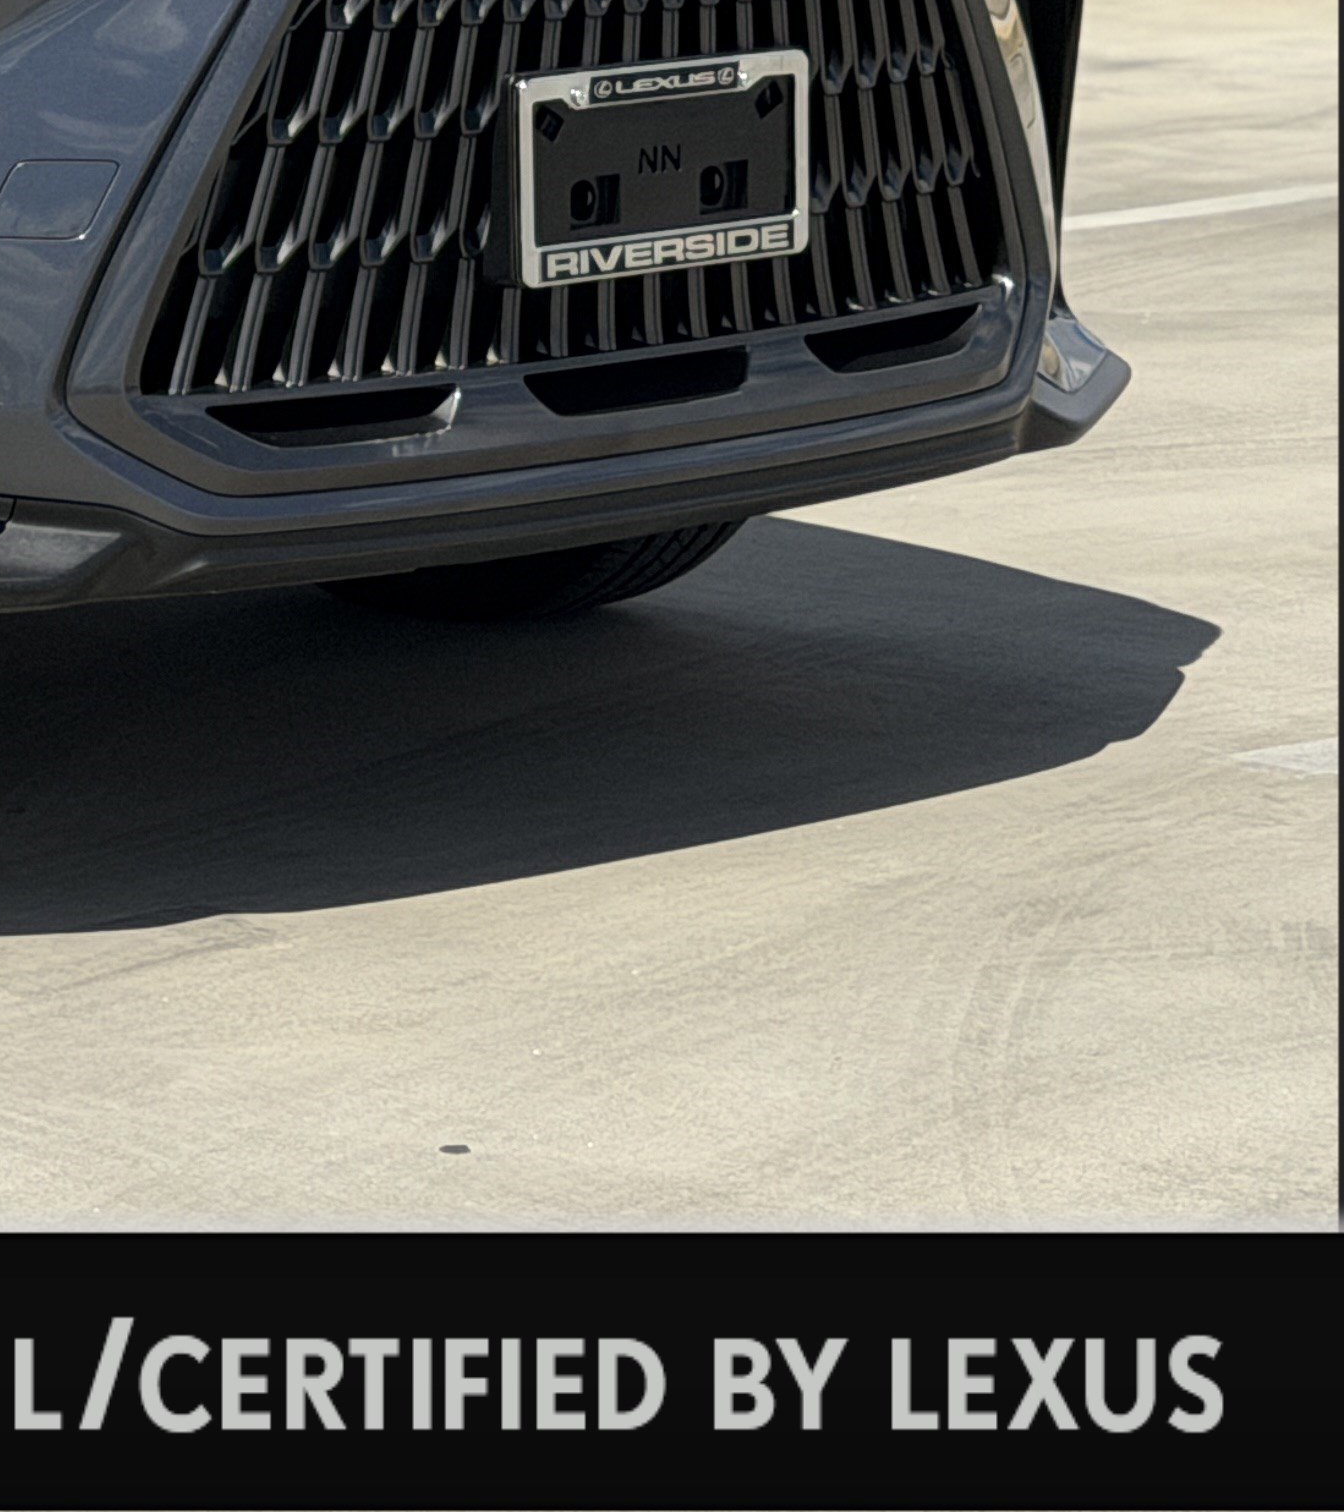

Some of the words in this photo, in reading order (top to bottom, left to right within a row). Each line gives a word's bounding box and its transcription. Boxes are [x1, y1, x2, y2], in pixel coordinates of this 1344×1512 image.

[615, 71, 716, 94] LEXUS
[637, 143, 682, 174] NN
[547, 223, 789, 278] RIVERSIDE
